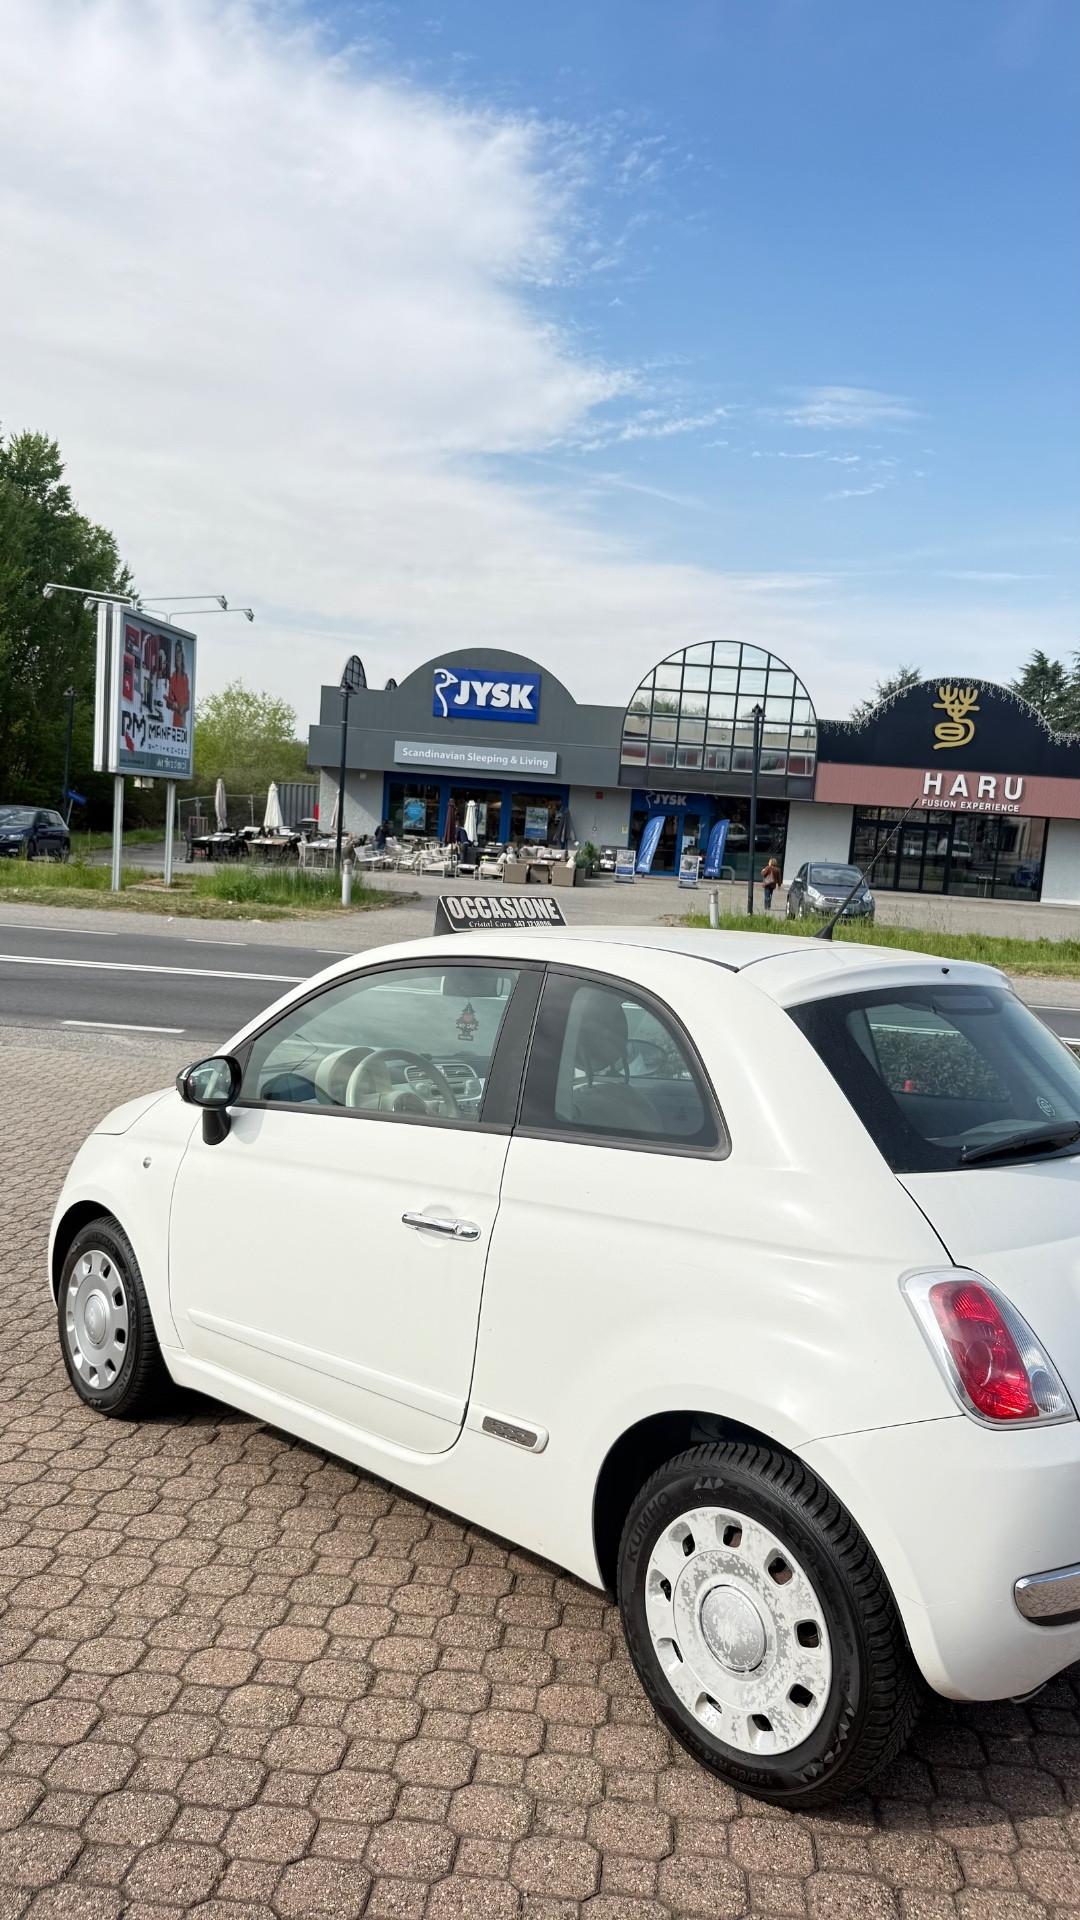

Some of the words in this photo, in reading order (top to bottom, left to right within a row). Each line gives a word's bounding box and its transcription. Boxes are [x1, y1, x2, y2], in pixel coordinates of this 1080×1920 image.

[454, 680, 535, 710] JYSK
[402, 747, 466, 760] Scandinavian
[467, 752, 508, 766] Sleeping
[510, 755, 517, 764] &
[520, 756, 549, 768] Living
[923, 772, 1023, 800] HARU
[653, 793, 687, 806] JYSK
[922, 799, 956, 808] FUSION
[960, 801, 1020, 812] EXPERIENCE
[446, 897, 561, 919] OCCASIONE
[626, 1492, 671, 1563] KUMHO
